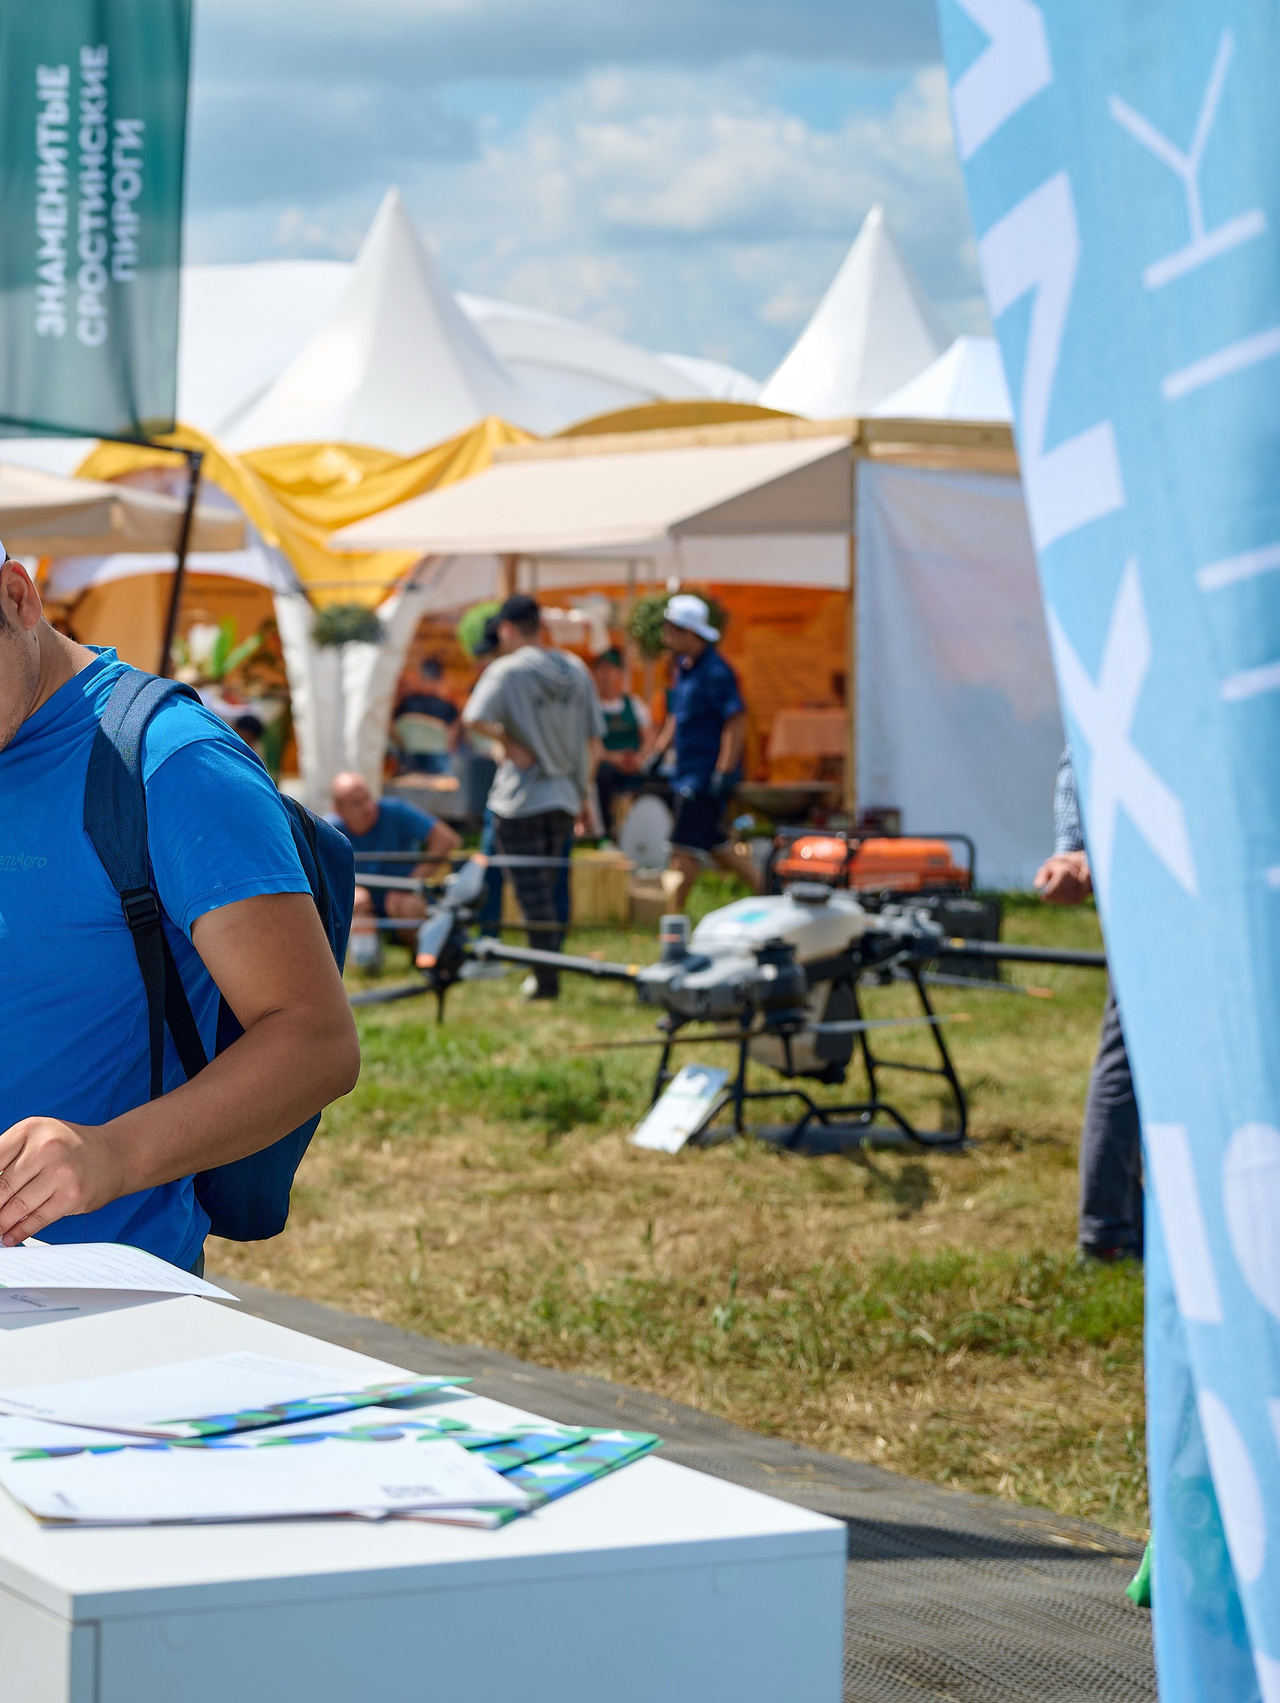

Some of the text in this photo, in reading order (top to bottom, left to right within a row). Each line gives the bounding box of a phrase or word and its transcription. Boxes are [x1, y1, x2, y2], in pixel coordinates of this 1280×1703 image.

[34, 64, 70, 338] ЗНАМЕНИТЫЕ
[75, 44, 108, 347] СРОСТИНСКИЕ
[110, 118, 145, 282] ПИРОГИ
